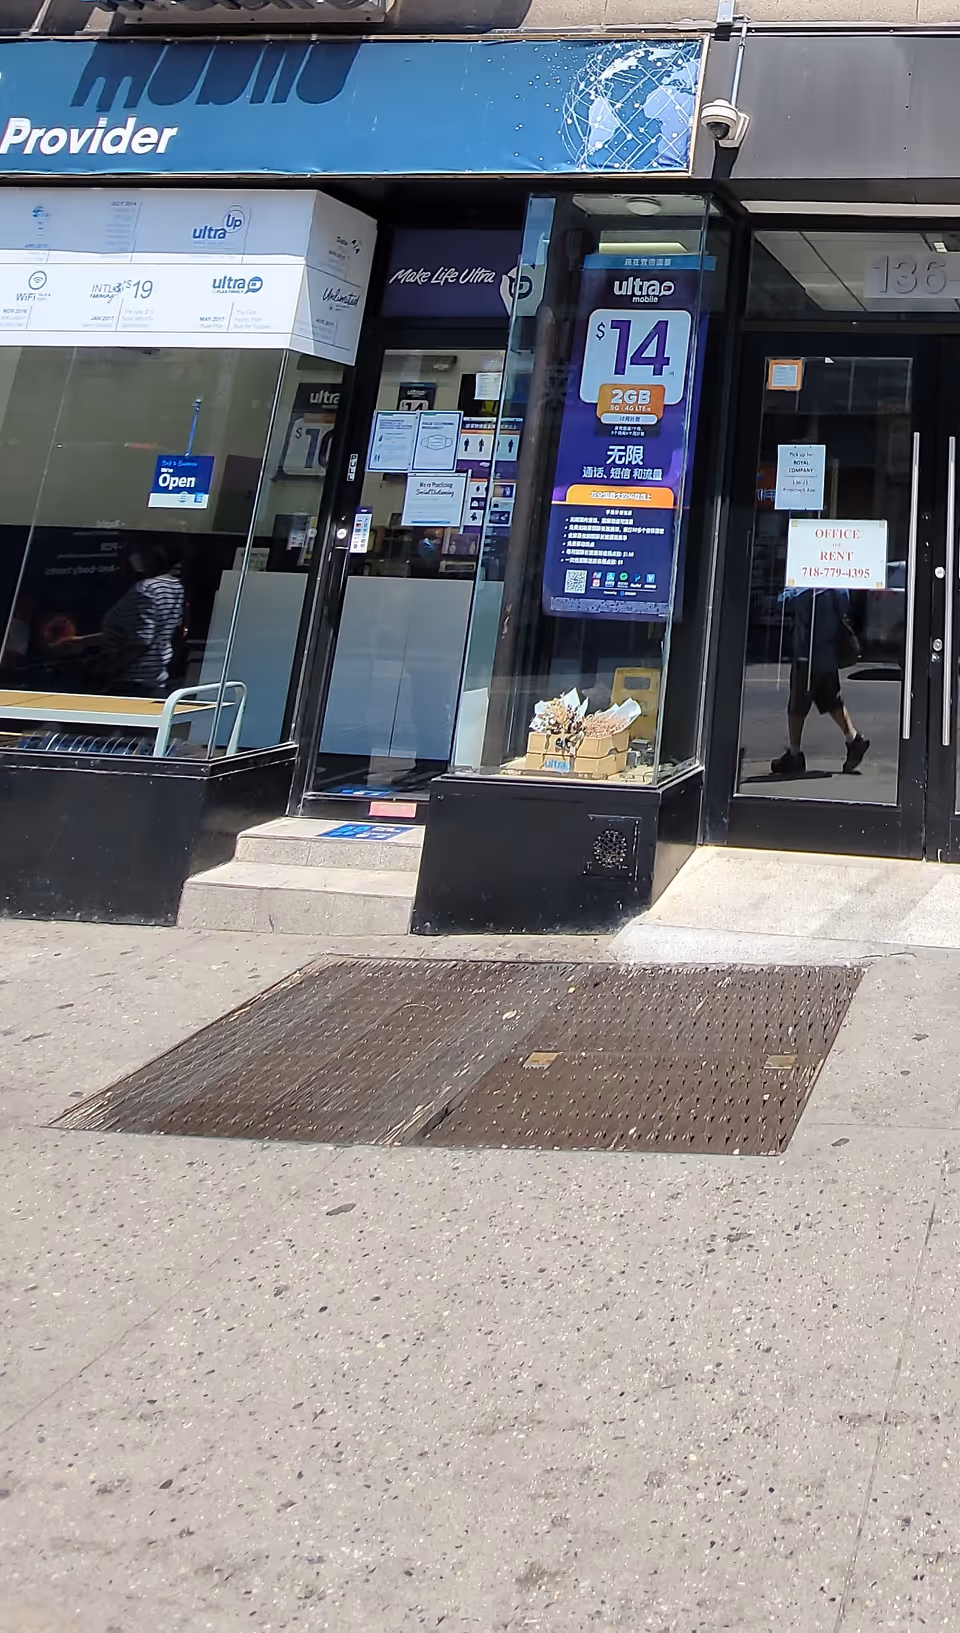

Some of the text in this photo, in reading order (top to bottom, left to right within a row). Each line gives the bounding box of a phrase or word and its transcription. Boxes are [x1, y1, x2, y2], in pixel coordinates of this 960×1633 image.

[0, 115, 178, 155] Provider
[192, 214, 242, 240] ultra Up
[212, 275, 246, 290] ultra
[389, 267, 496, 286] Make Life Ultra
[613, 276, 660, 295] ultra
[16, 292, 36, 301] WiFi
[611, 389, 651, 404] 2GB
[606, 445, 644, 465] 无限
[158, 473, 196, 490] Open
[814, 529, 860, 539] OFFICE
[820, 551, 854, 561] RENT
[802, 567, 870, 579] 718-779-4395
